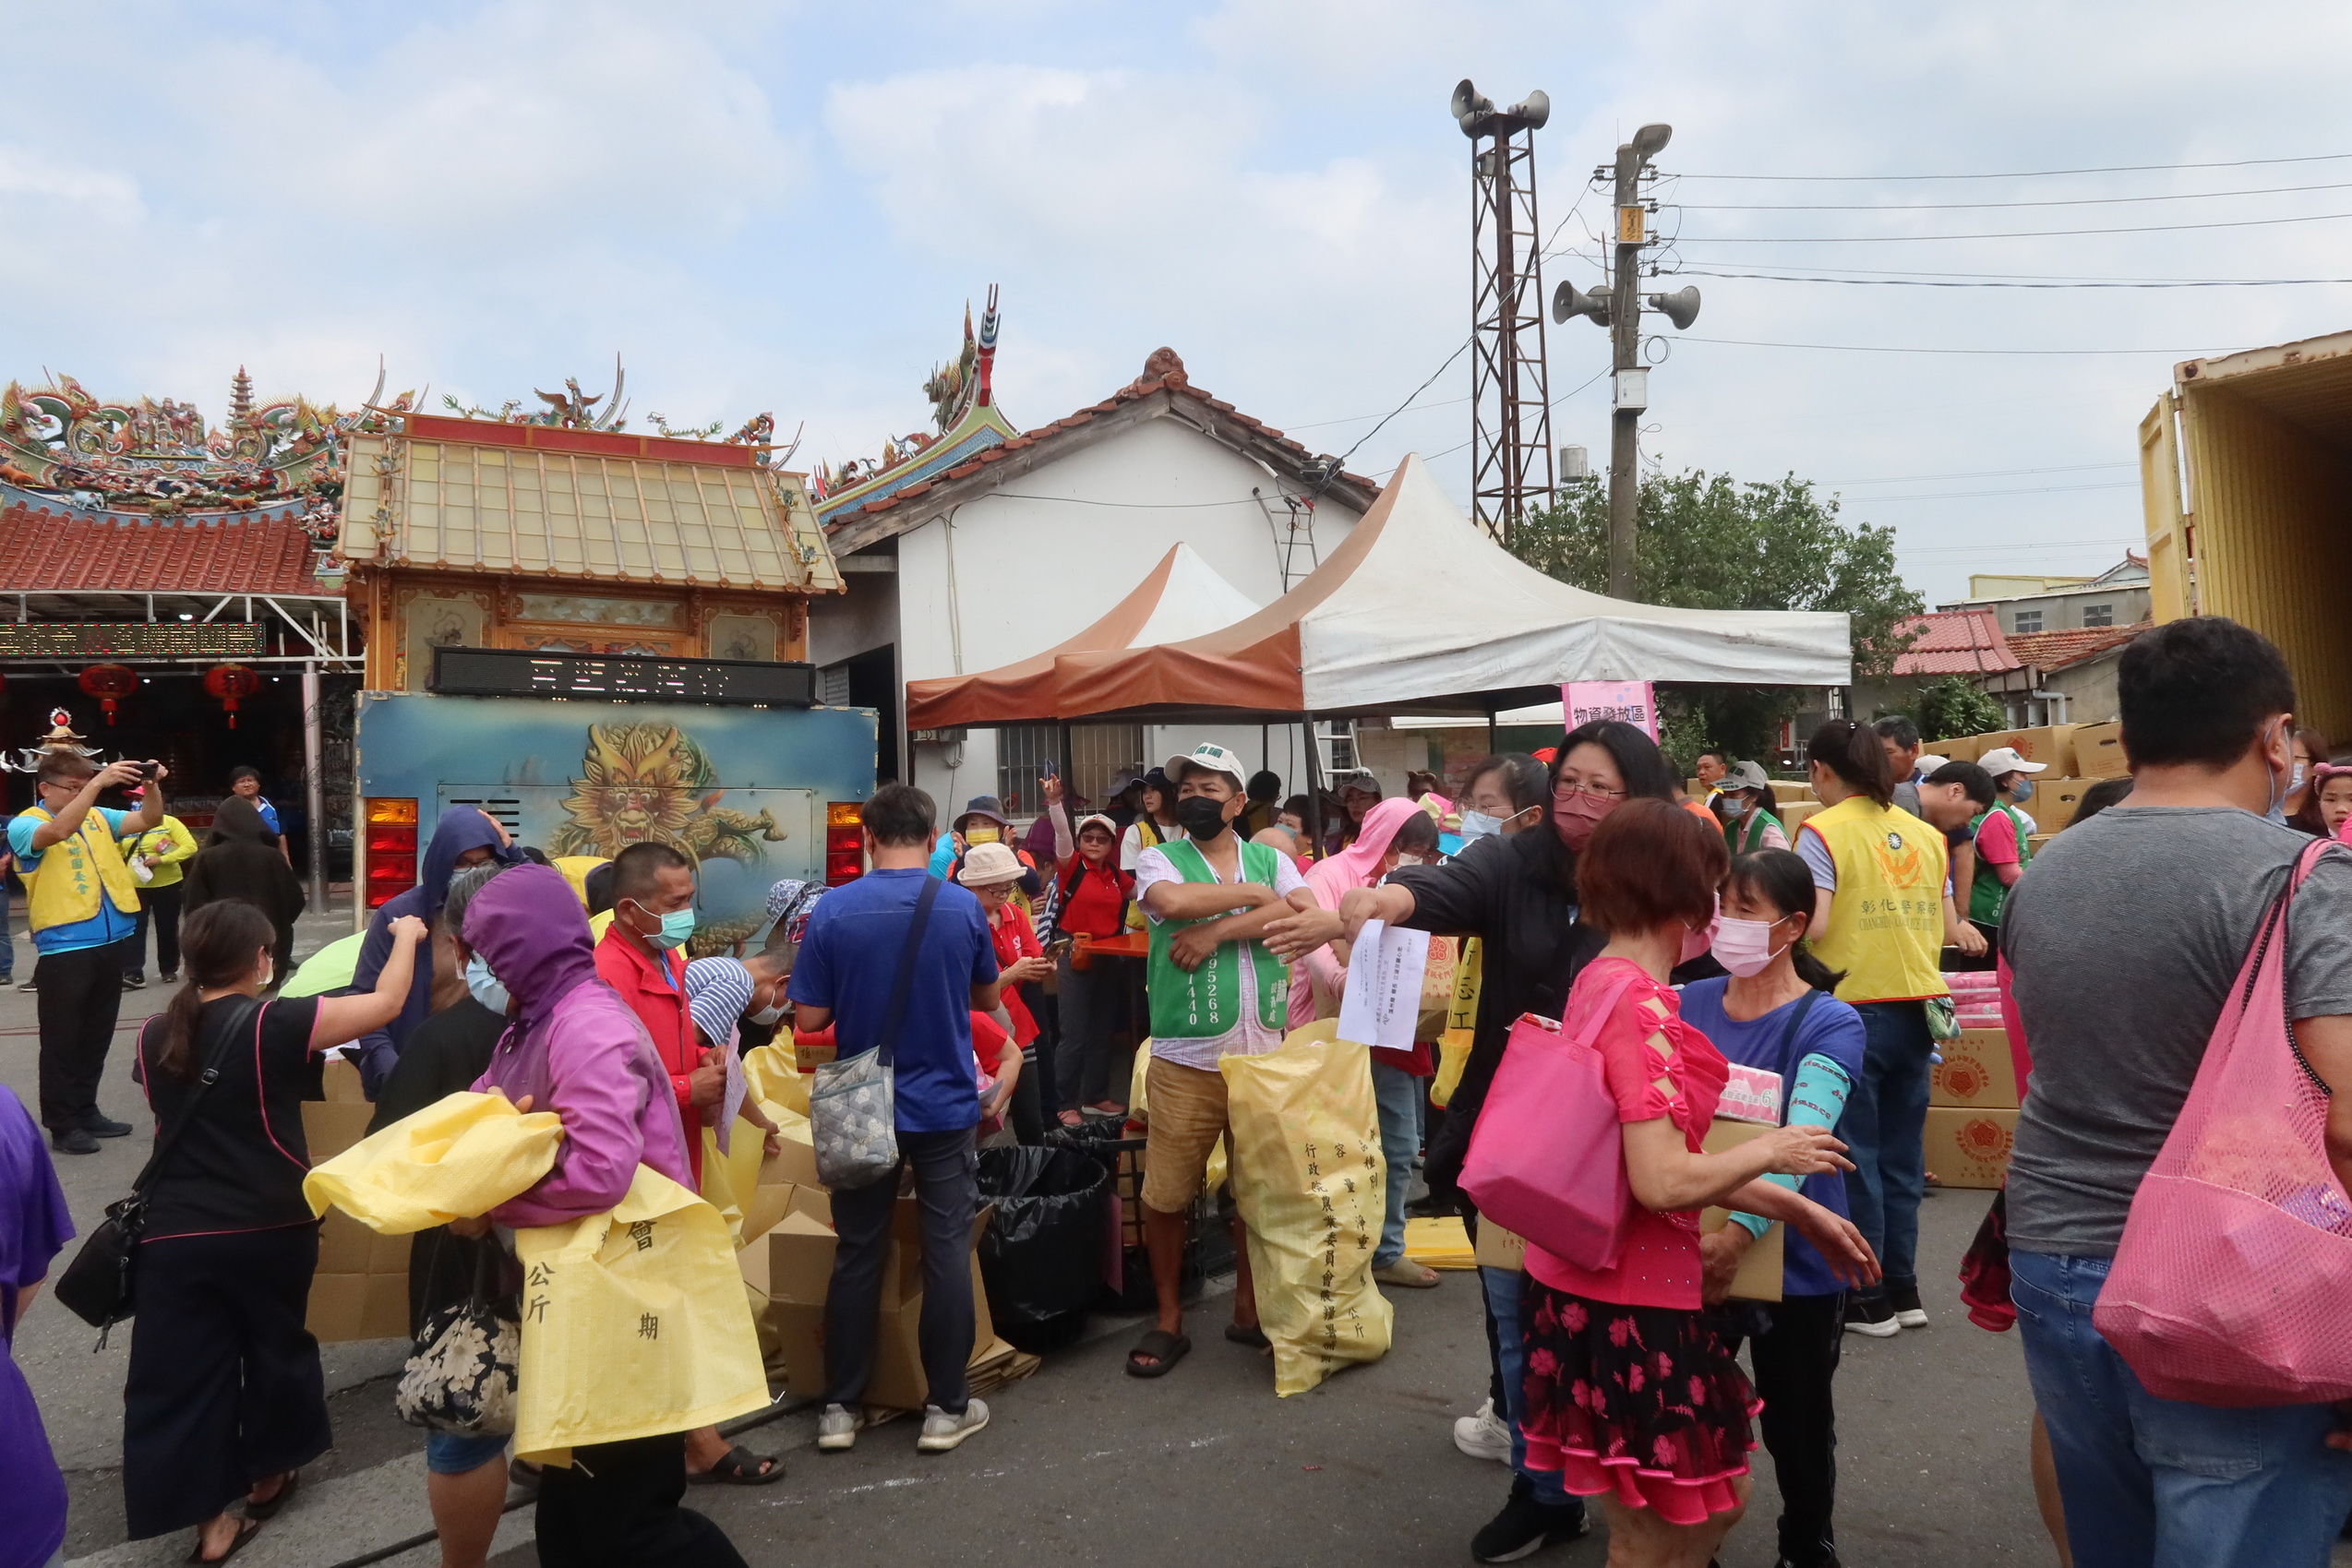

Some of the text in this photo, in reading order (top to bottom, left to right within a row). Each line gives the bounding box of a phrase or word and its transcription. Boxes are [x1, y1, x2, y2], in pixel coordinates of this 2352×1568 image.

[1573, 705, 1646, 725] 物資發放區
[1761, 1089, 1773, 1107] 6
[1791, 1097, 1831, 1120] dance
[526, 1262, 556, 1323] 公斤
[638, 1311, 658, 1341] 期
[1348, 1307, 1364, 1338] 公斤
